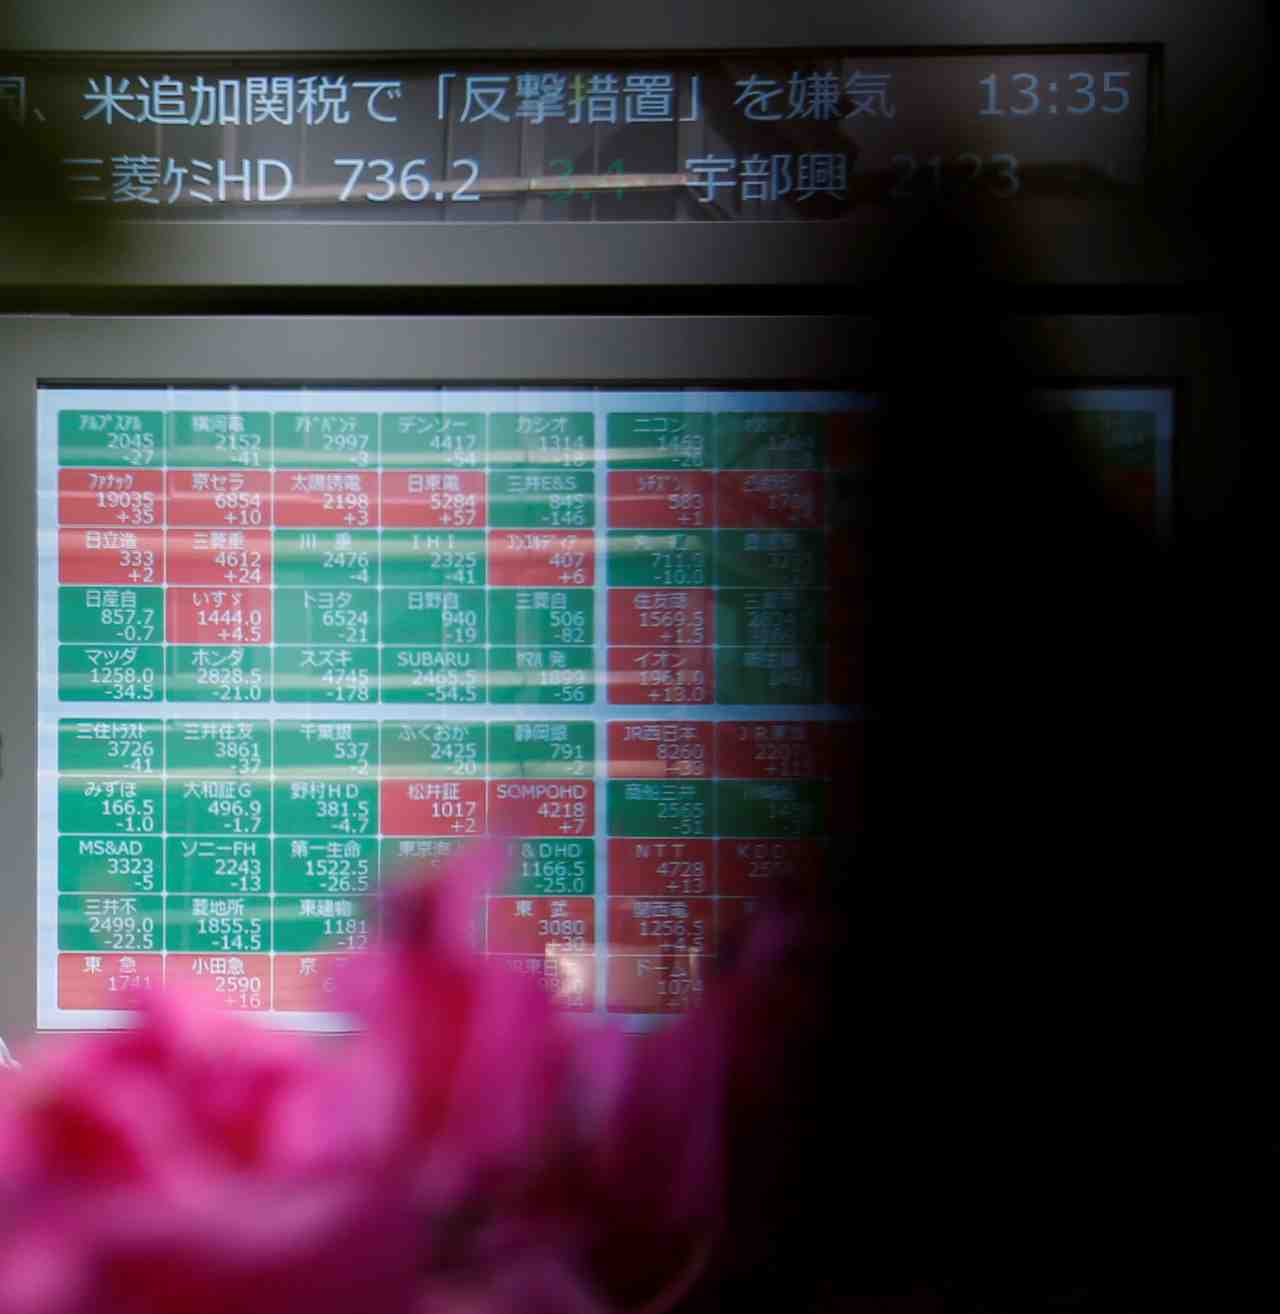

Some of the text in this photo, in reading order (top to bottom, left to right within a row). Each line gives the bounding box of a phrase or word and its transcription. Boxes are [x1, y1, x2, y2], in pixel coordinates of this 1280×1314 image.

[978, 71, 1131, 118] 13:35
[333, 160, 480, 203] 736.2
[686, 154, 847, 203] 宇部興
[120, 551, 154, 567] 333
[215, 551, 262, 567] 4612
[224, 567, 262, 583] +24
[86, 590, 137, 609] 日産自
[304, 591, 353, 609] トヨタ
[101, 608, 154, 626] 857.7
[197, 609, 262, 626] 1444.0
[322, 610, 369, 626] 6524
[441, 610, 477, 627] 940
[549, 611, 585, 627] 506
[116, 625, 154, 642] -0.7
[218, 625, 262, 642] +4.5
[85, 647, 138, 666] マツダ
[192, 647, 245, 667] ホンダ
[300, 649, 353, 667] スズキ
[397, 651, 470, 667] SUBARU
[91, 668, 154, 684] 1258.0
[105, 684, 154, 700] -34.5
[212, 684, 262, 701] -21.0
[326, 685, 369, 701] -178
[427, 686, 477, 702] -54.5
[554, 686, 585, 702] -56
[107, 741, 154, 758] 3726
[215, 741, 261, 758] 3861
[335, 742, 369, 759] 537
[84, 781, 138, 798] みずほ
[101, 799, 154, 816] 166.5
[208, 800, 262, 817] 496.9
[316, 801, 369, 818] 381.5
[432, 801, 476, 818] 1017
[537, 802, 585, 819] 4218
[116, 816, 154, 832] -1.0
[224, 816, 262, 833] -1.7
[331, 818, 369, 834] -4.7
[78, 840, 144, 856] MS&AD
[182, 841, 257, 858] ソニーFH
[107, 858, 154, 875] 3323
[215, 859, 262, 876] 2243
[305, 860, 369, 877] 1522.5
[230, 876, 262, 892] -13
[320, 877, 369, 893] -26.5
[83, 898, 138, 916] 三井不
[89, 917, 154, 933] 2499.0
[197, 918, 262, 935] 1855.5
[104, 934, 154, 950] -22.5
[212, 934, 262, 951] -14.5
[215, 976, 262, 992] 2590
